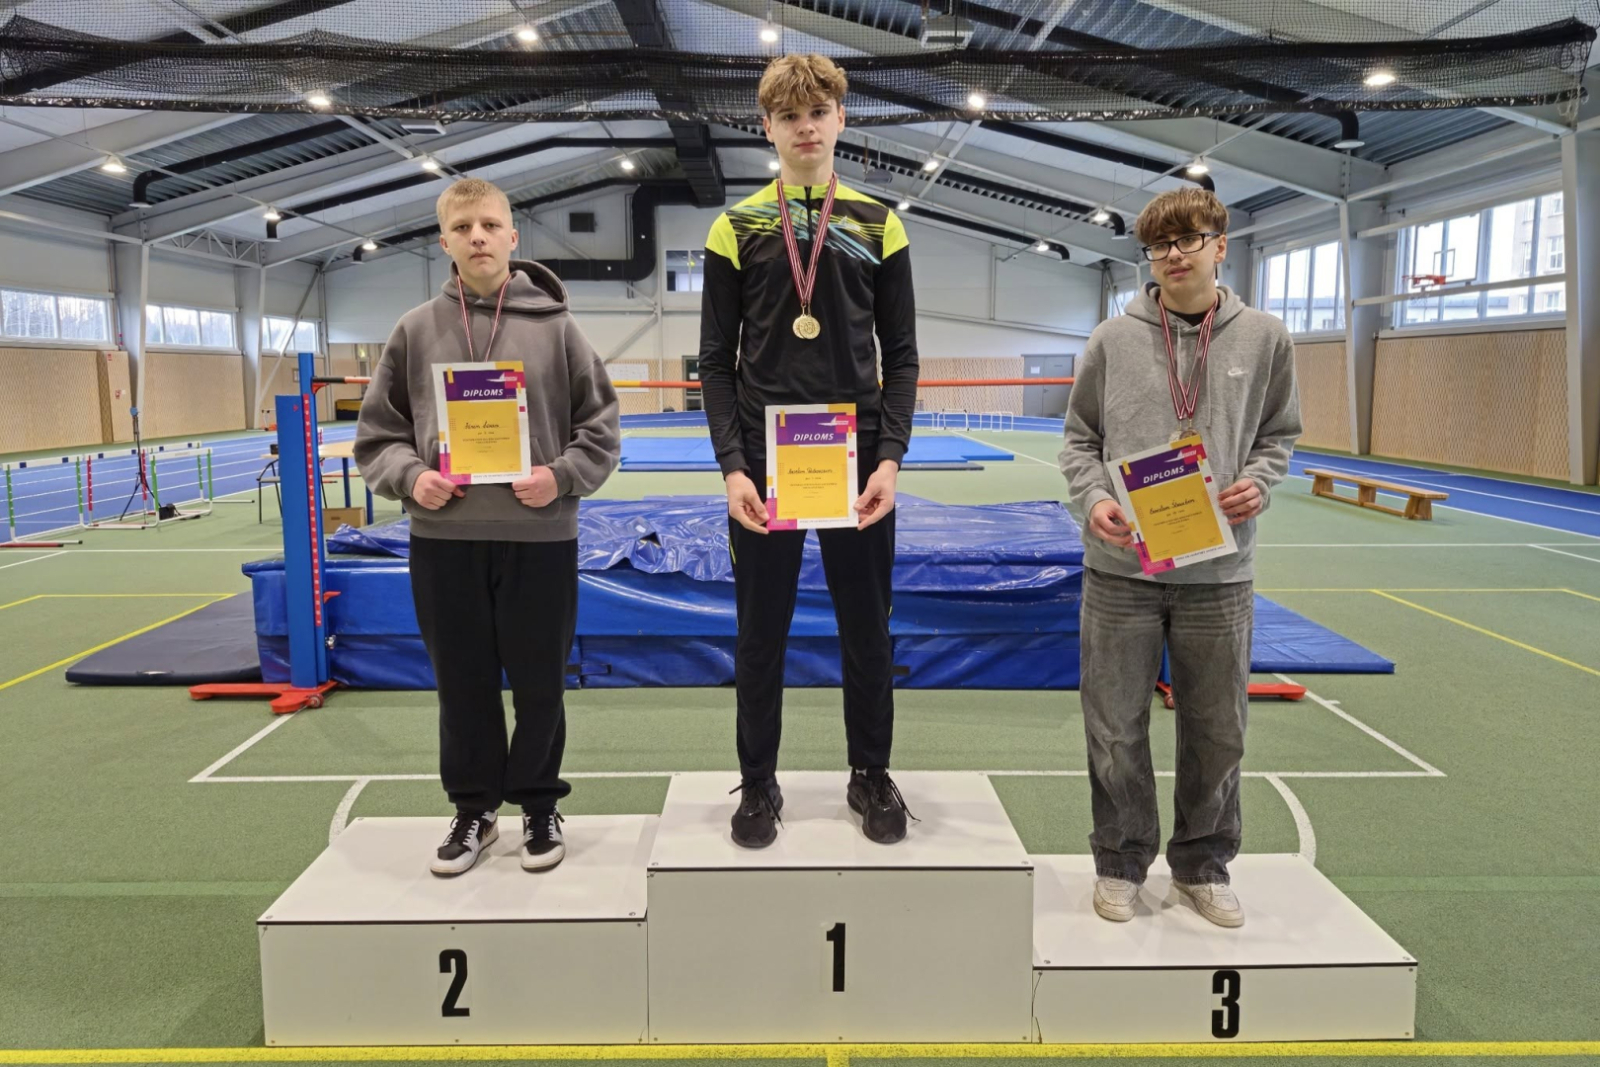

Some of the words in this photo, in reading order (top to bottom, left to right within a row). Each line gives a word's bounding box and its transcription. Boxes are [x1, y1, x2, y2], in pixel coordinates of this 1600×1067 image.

[463, 388, 504, 398] DIPLOMS
[793, 433, 835, 442] DIPLOMS
[1142, 465, 1185, 484] DIPLOMS
[827, 922, 846, 993] 1
[439, 949, 471, 1018] 2
[1211, 969, 1241, 1039] 3
